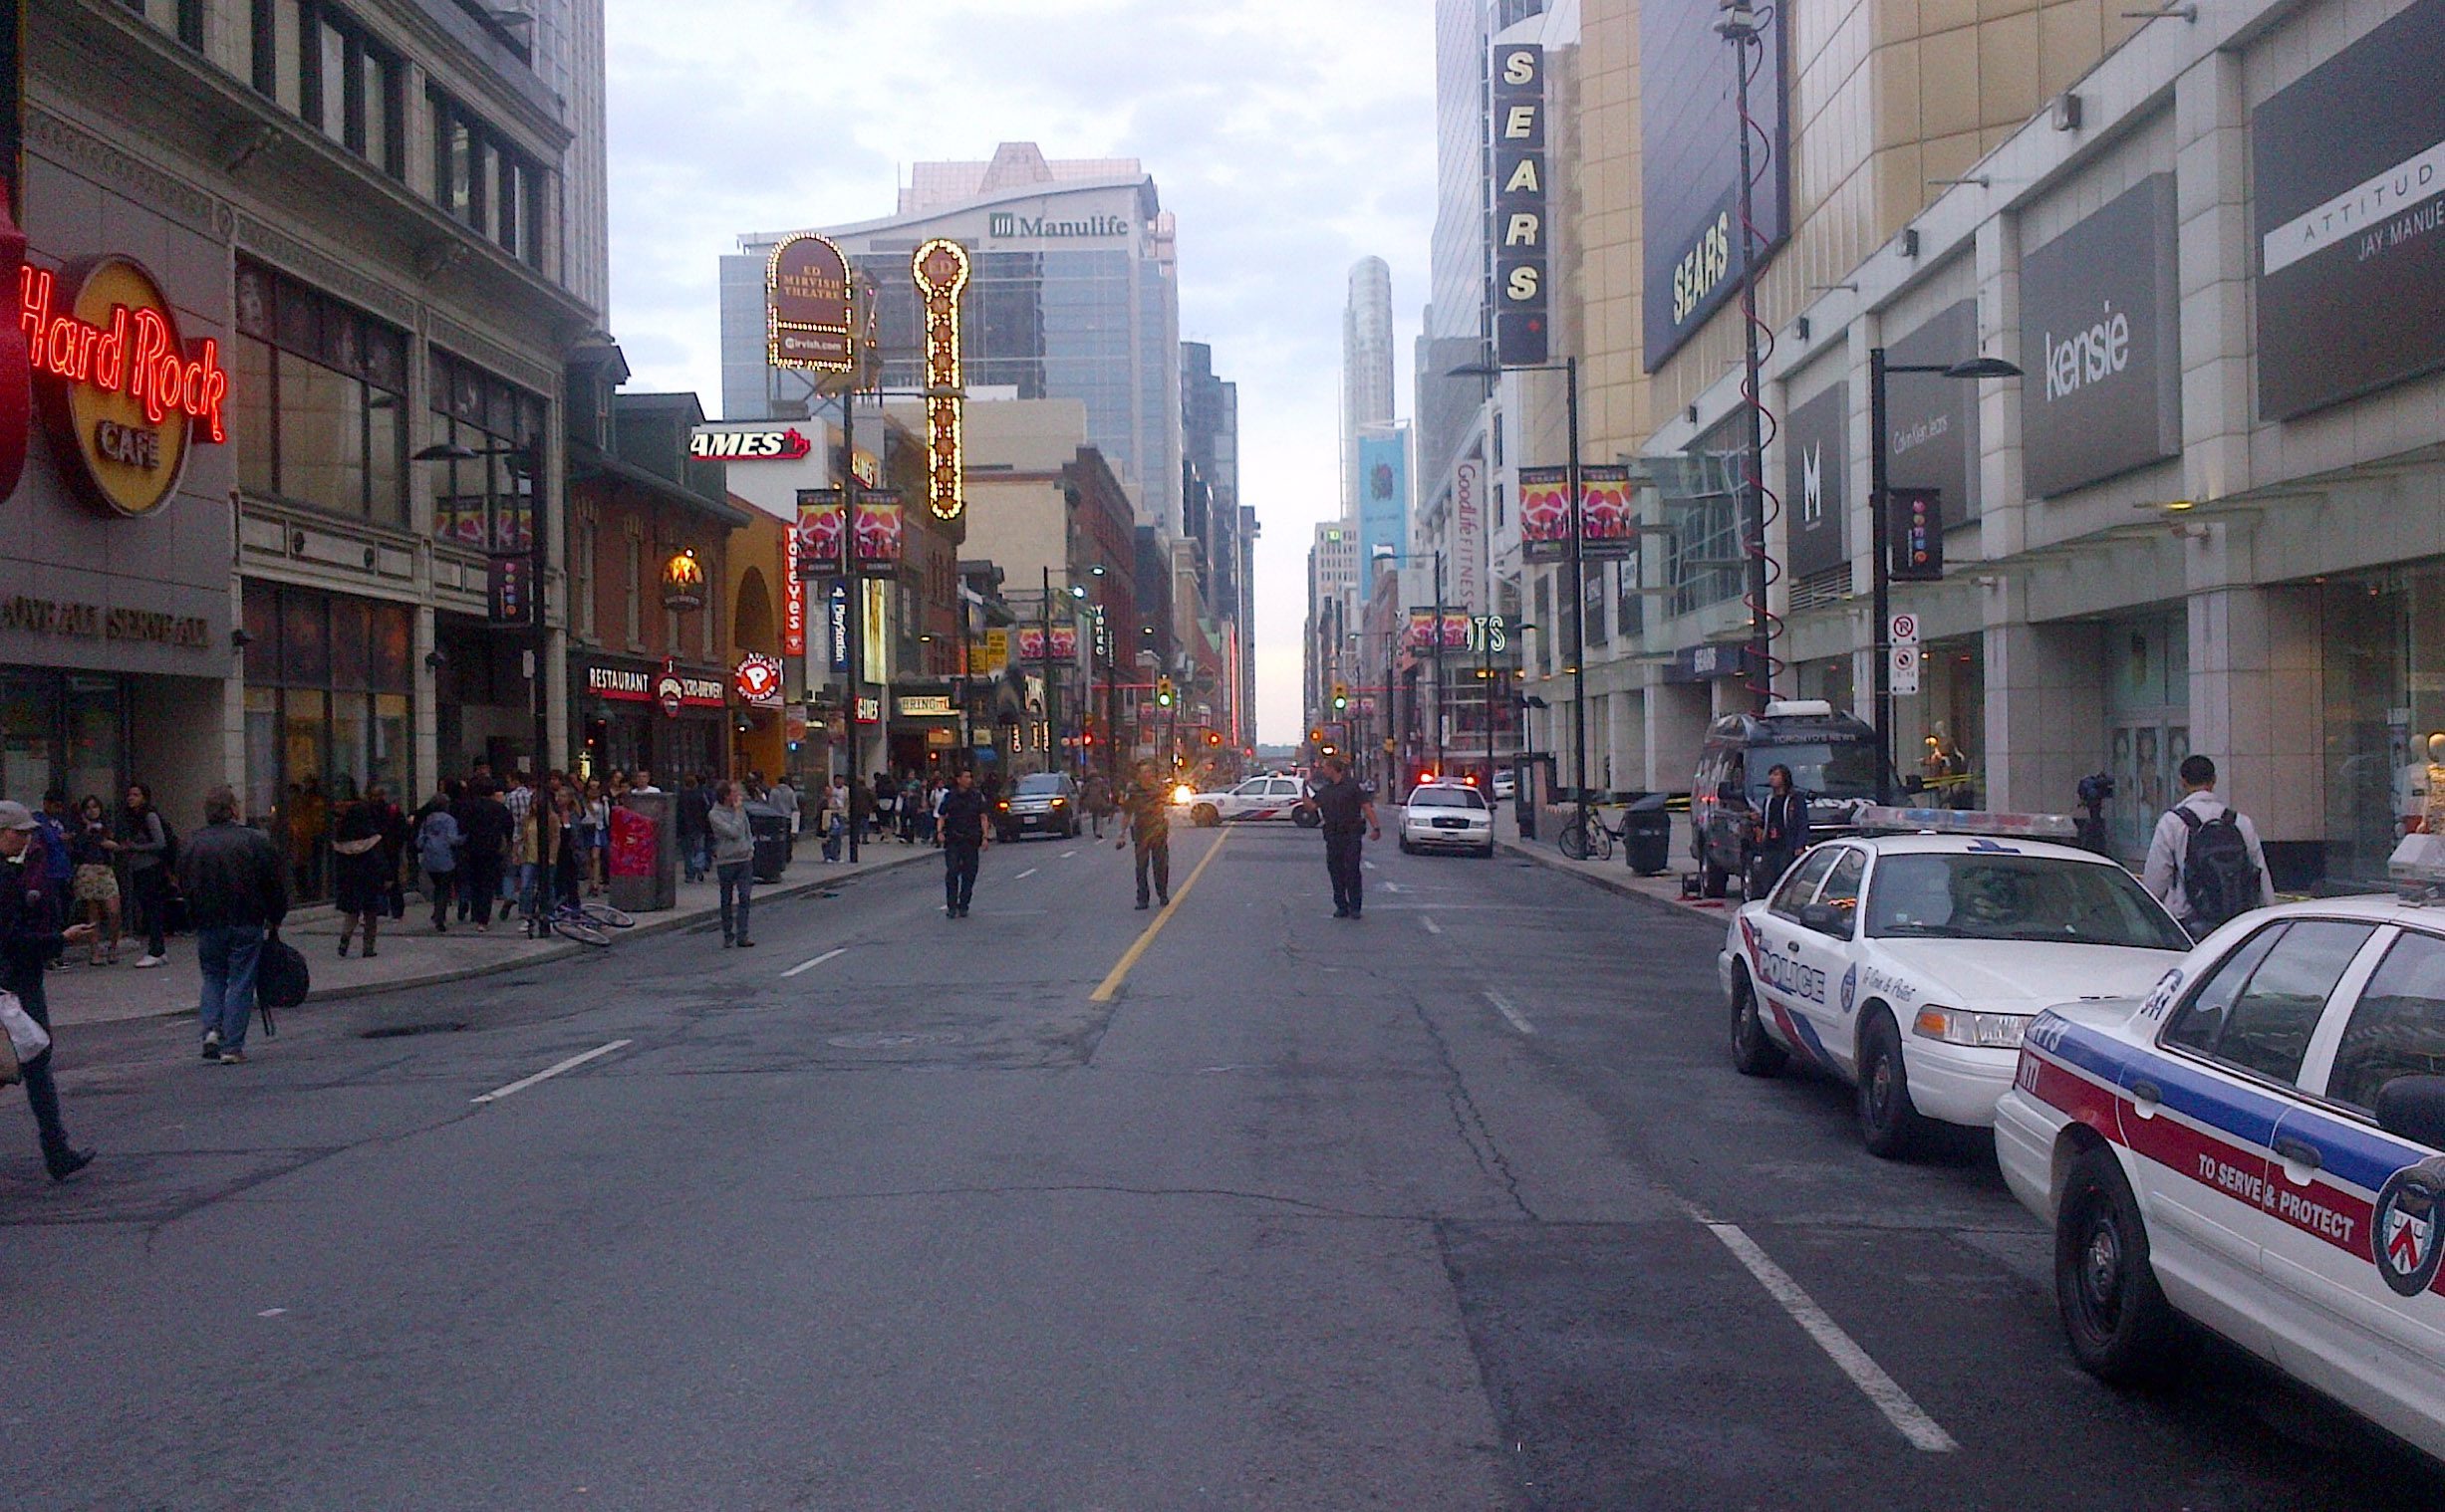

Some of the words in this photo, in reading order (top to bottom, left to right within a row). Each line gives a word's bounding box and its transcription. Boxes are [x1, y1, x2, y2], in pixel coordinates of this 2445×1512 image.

[1502, 51, 1540, 301] SEARS
[1018, 214, 1128, 237] Manulife
[2357, 229, 2385, 262] JAY
[783, 275, 841, 290] MIRVISH
[784, 286, 840, 300] THEATRE
[803, 265, 821, 276] ED
[1673, 210, 1729, 325] SEARS
[21, 265, 126, 390] Hard
[133, 308, 225, 442] Rock
[2044, 299, 2129, 402] kensie
[832, 604, 846, 662] PlayStation
[589, 667, 650, 693] RESTAURANT
[1760, 948, 1826, 1005] POLICE
[2198, 1152, 2216, 1180] TO
[2218, 1162, 2264, 1202] SERVE
[2264, 1183, 2277, 1209] &
[2279, 1189, 2356, 1243] PROTECT
